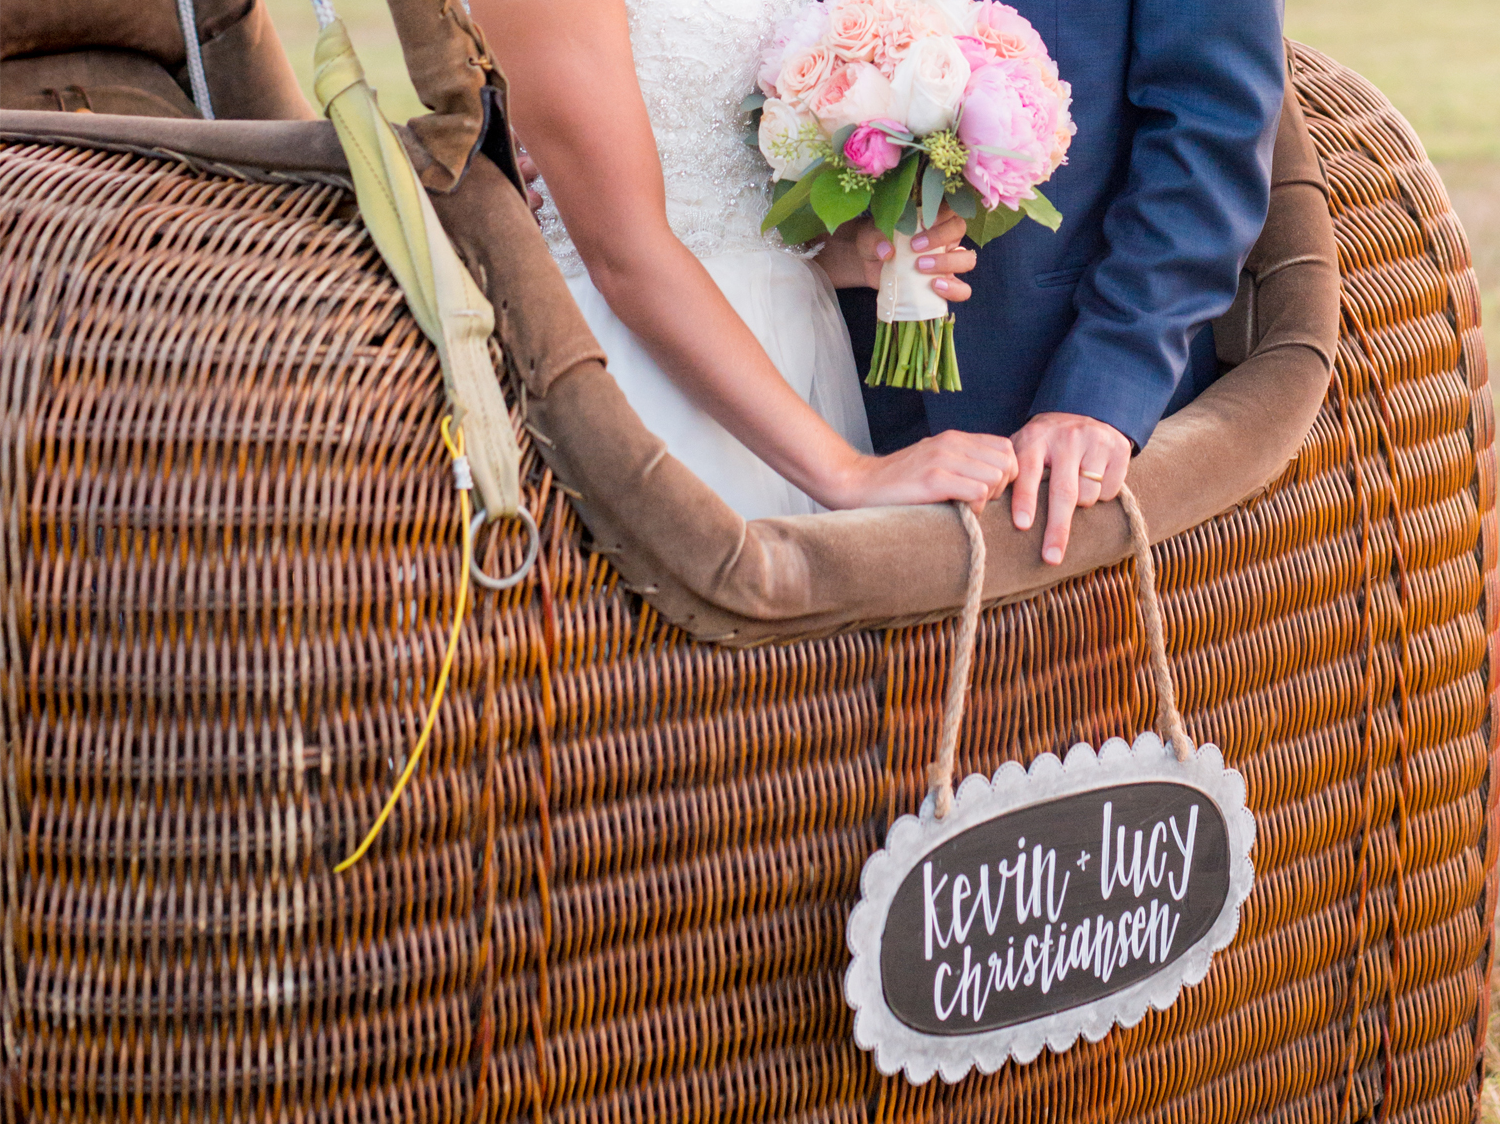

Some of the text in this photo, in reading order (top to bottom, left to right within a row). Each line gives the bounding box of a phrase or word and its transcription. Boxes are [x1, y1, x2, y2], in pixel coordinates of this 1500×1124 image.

[1076, 850, 1091, 871] +
[1100, 801, 1199, 901] lucy
[934, 898, 1180, 1022] christiansen
